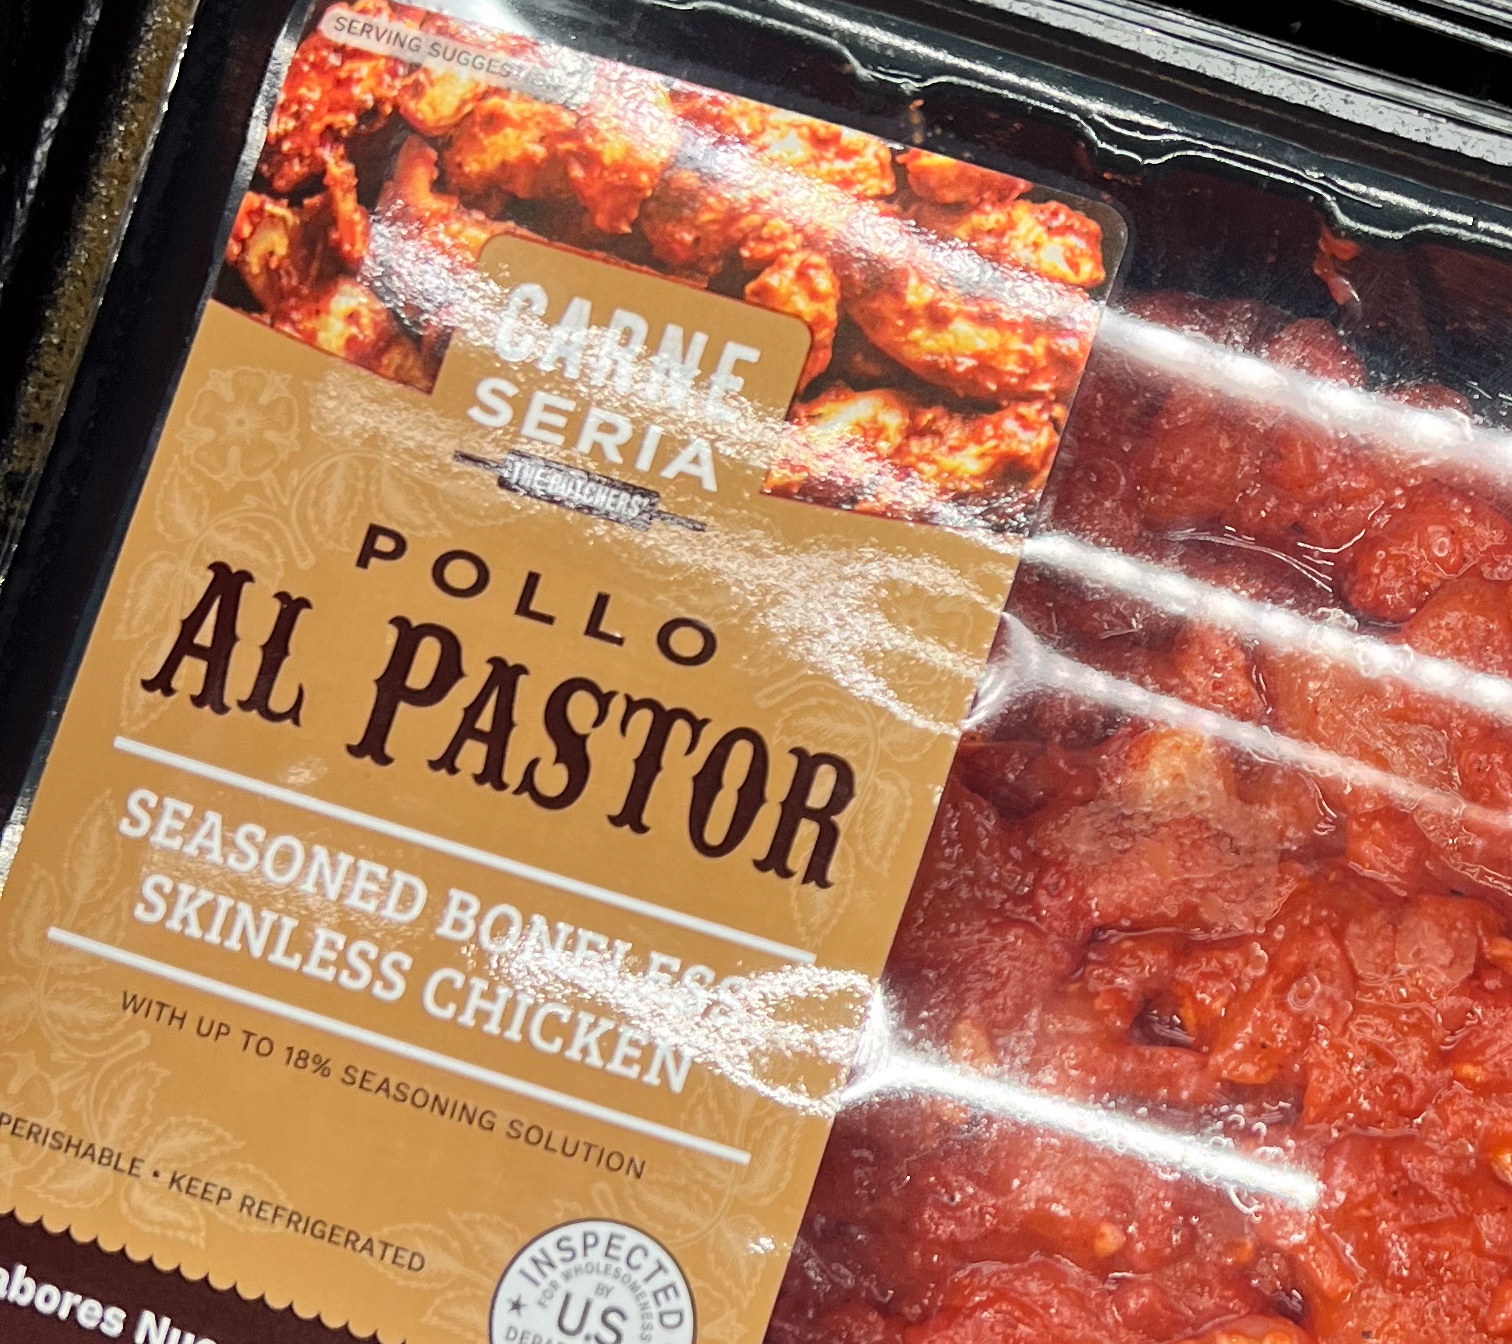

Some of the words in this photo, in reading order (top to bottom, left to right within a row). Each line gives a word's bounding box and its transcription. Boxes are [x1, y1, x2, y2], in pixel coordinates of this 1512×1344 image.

[333, 16, 422, 53] SERVING
[467, 377, 717, 492] SERIA
[354, 522, 717, 667] POLLO
[140, 560, 313, 727] AL
[345, 614, 854, 889] PASTOR
[118, 788, 427, 923] SEASONED
[133, 873, 412, 1001] SKINLESS
[423, 969, 697, 1094] CHICKEN
[121, 989, 187, 1030] WITH
[195, 1015, 230, 1042] UP
[241, 1029, 274, 1057] TO
[284, 1045, 331, 1078] 18%
[339, 1064, 496, 1132] SEASONING
[505, 1118, 645, 1179] SOLUTION
[0, 1112, 145, 1178] PERISHABLE
[167, 1169, 232, 1206] KEEP
[238, 1194, 425, 1272] REFRIGERATED
[0, 1264, 127, 1338] bores
[519, 1231, 684, 1330] INSPECTED
[538, 1280, 560, 1309] FOR
[561, 1261, 654, 1342] WHOLESOMENESS
[595, 1283, 614, 1298] BY
